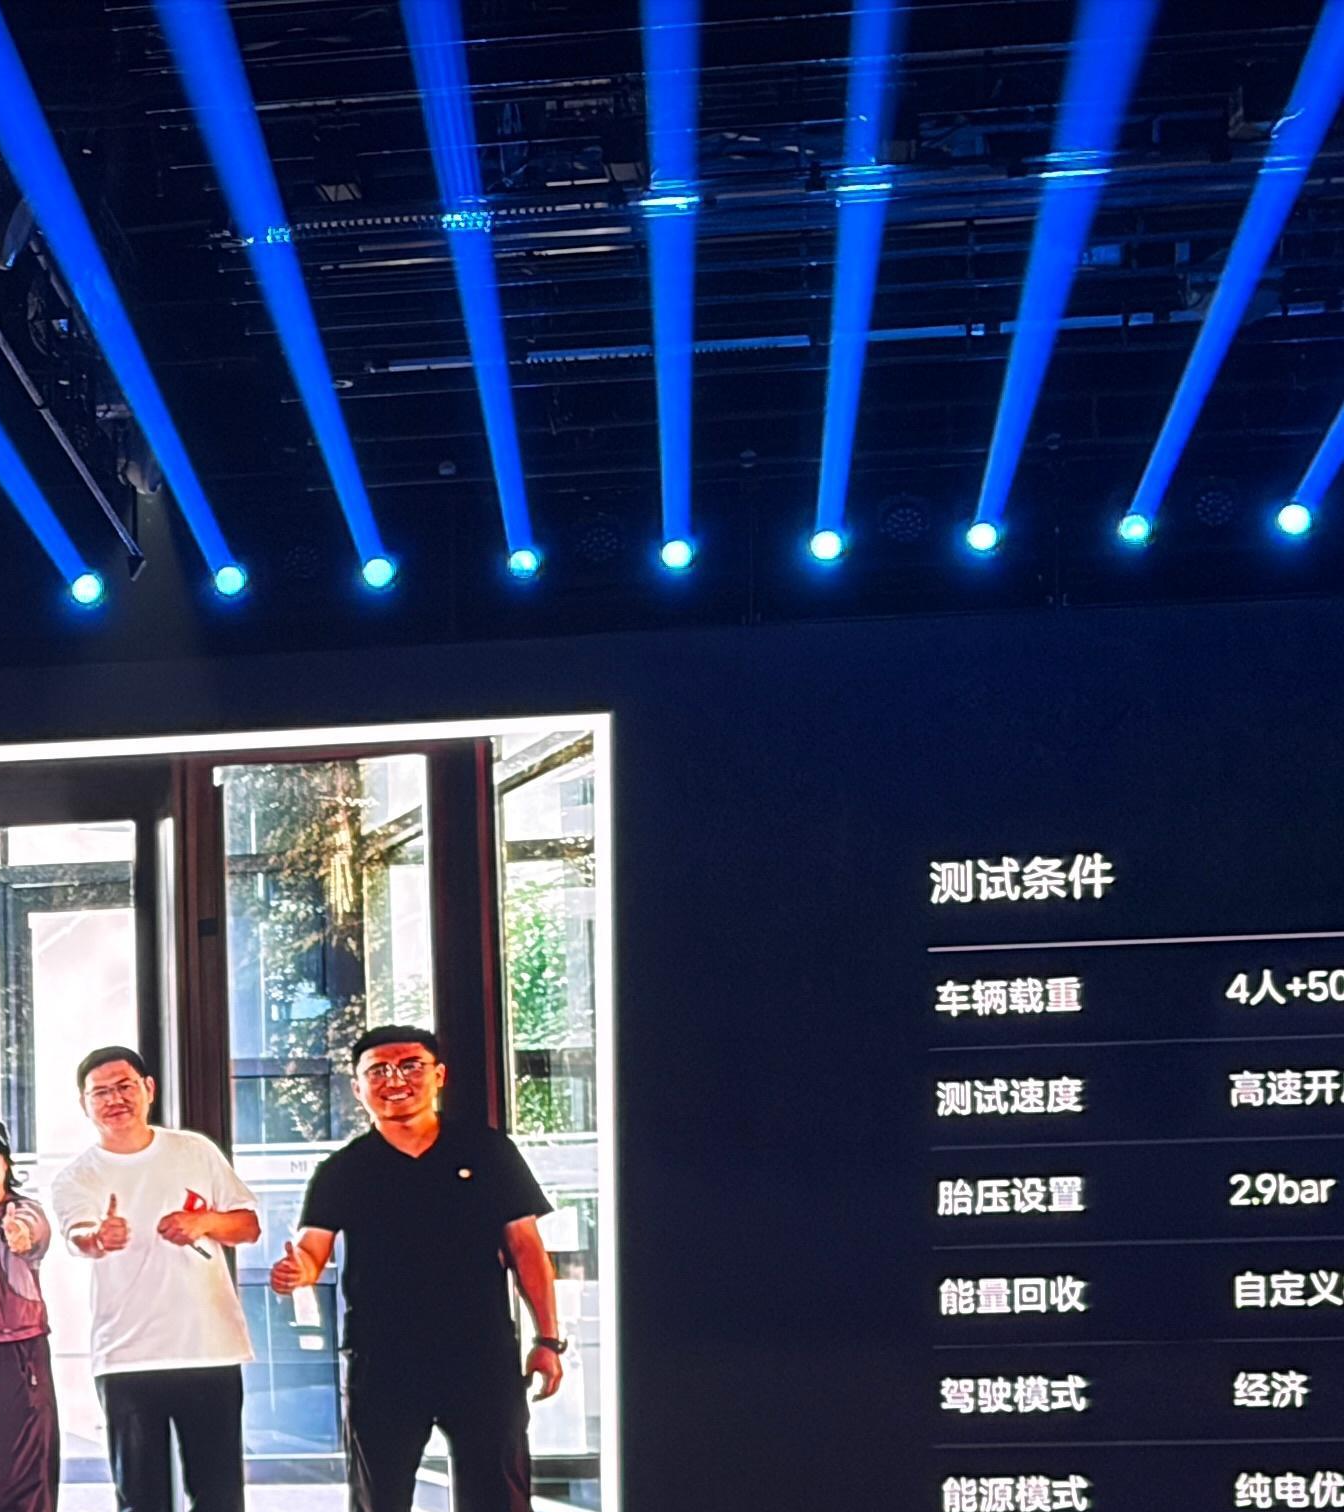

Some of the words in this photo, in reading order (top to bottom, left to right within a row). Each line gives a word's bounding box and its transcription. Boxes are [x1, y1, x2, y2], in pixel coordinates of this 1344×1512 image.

[929, 853, 1114, 905] 测试条件
[934, 976, 1083, 1017] 车辆载重
[1225, 968, 1344, 1006] 4人+50
[935, 1076, 1084, 1116] 测试速度
[1228, 1069, 1344, 1107] 高速开
[937, 1176, 1085, 1215] 胎压设置
[1229, 1172, 1337, 1206] 2.9bar
[939, 1275, 1087, 1315] 能量回收
[1234, 1269, 1344, 1309] 自定义
[940, 1375, 1088, 1414] 驾驶模式
[1233, 1370, 1310, 1408] 经济
[1234, 1470, 1344, 1509] 纯电优
